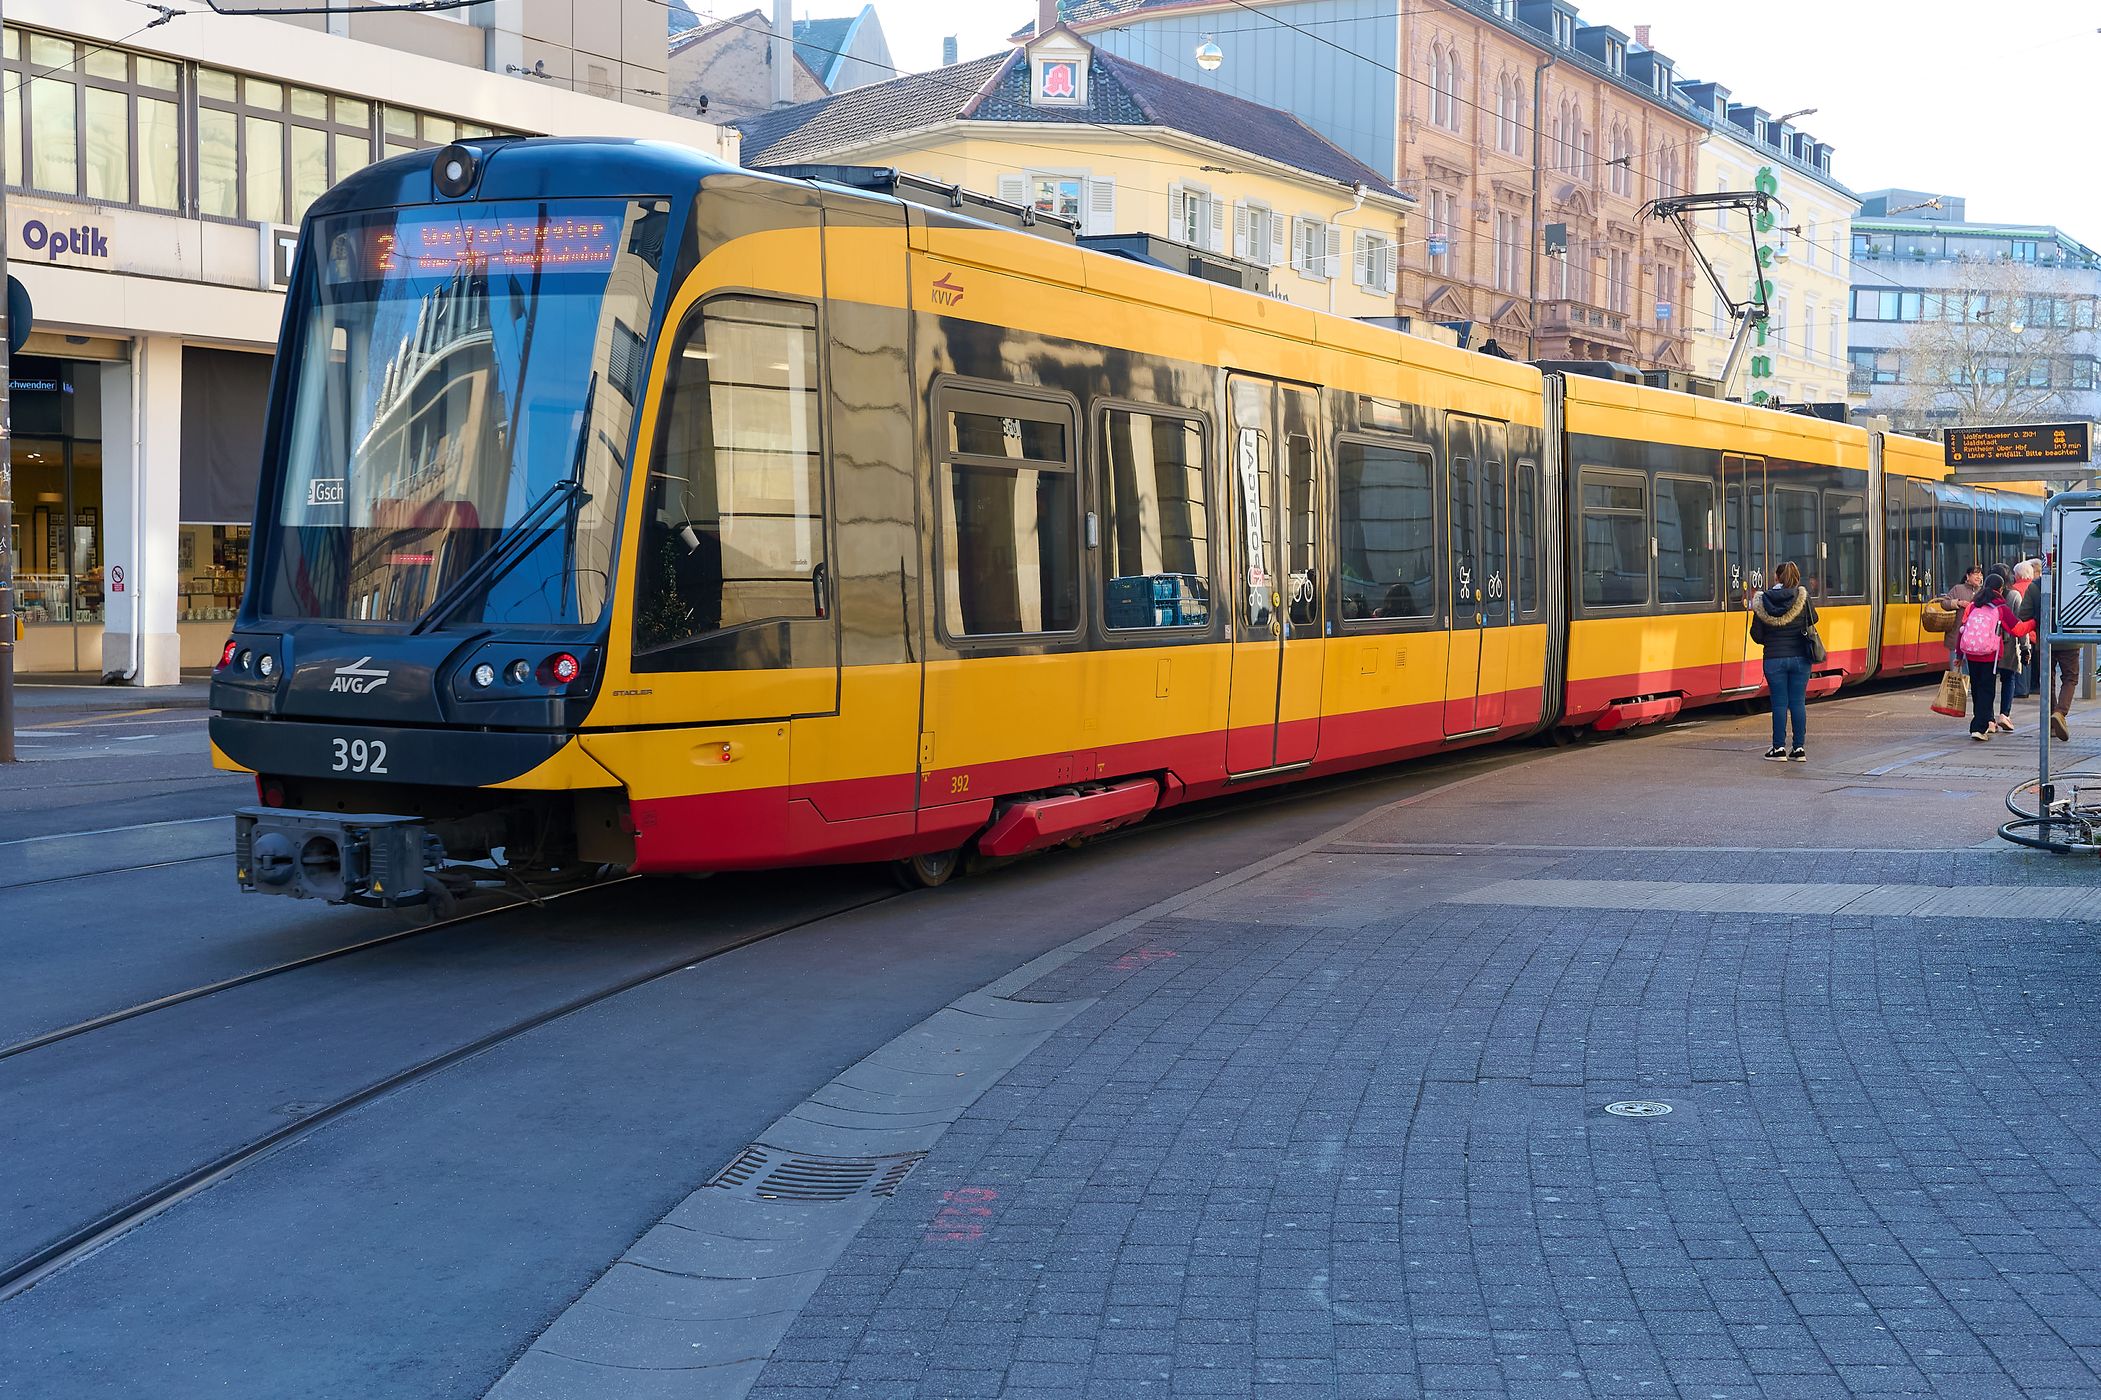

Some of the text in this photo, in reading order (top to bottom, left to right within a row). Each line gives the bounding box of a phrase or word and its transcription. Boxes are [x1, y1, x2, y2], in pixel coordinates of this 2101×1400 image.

[22, 219, 108, 260] Optik
[376, 234, 396, 271] 2
[931, 289, 952, 305] KVV
[330, 676, 363, 693] AVG
[612, 689, 653, 697] STADLER
[332, 738, 388, 774] 392
[950, 774, 969, 794] 392
